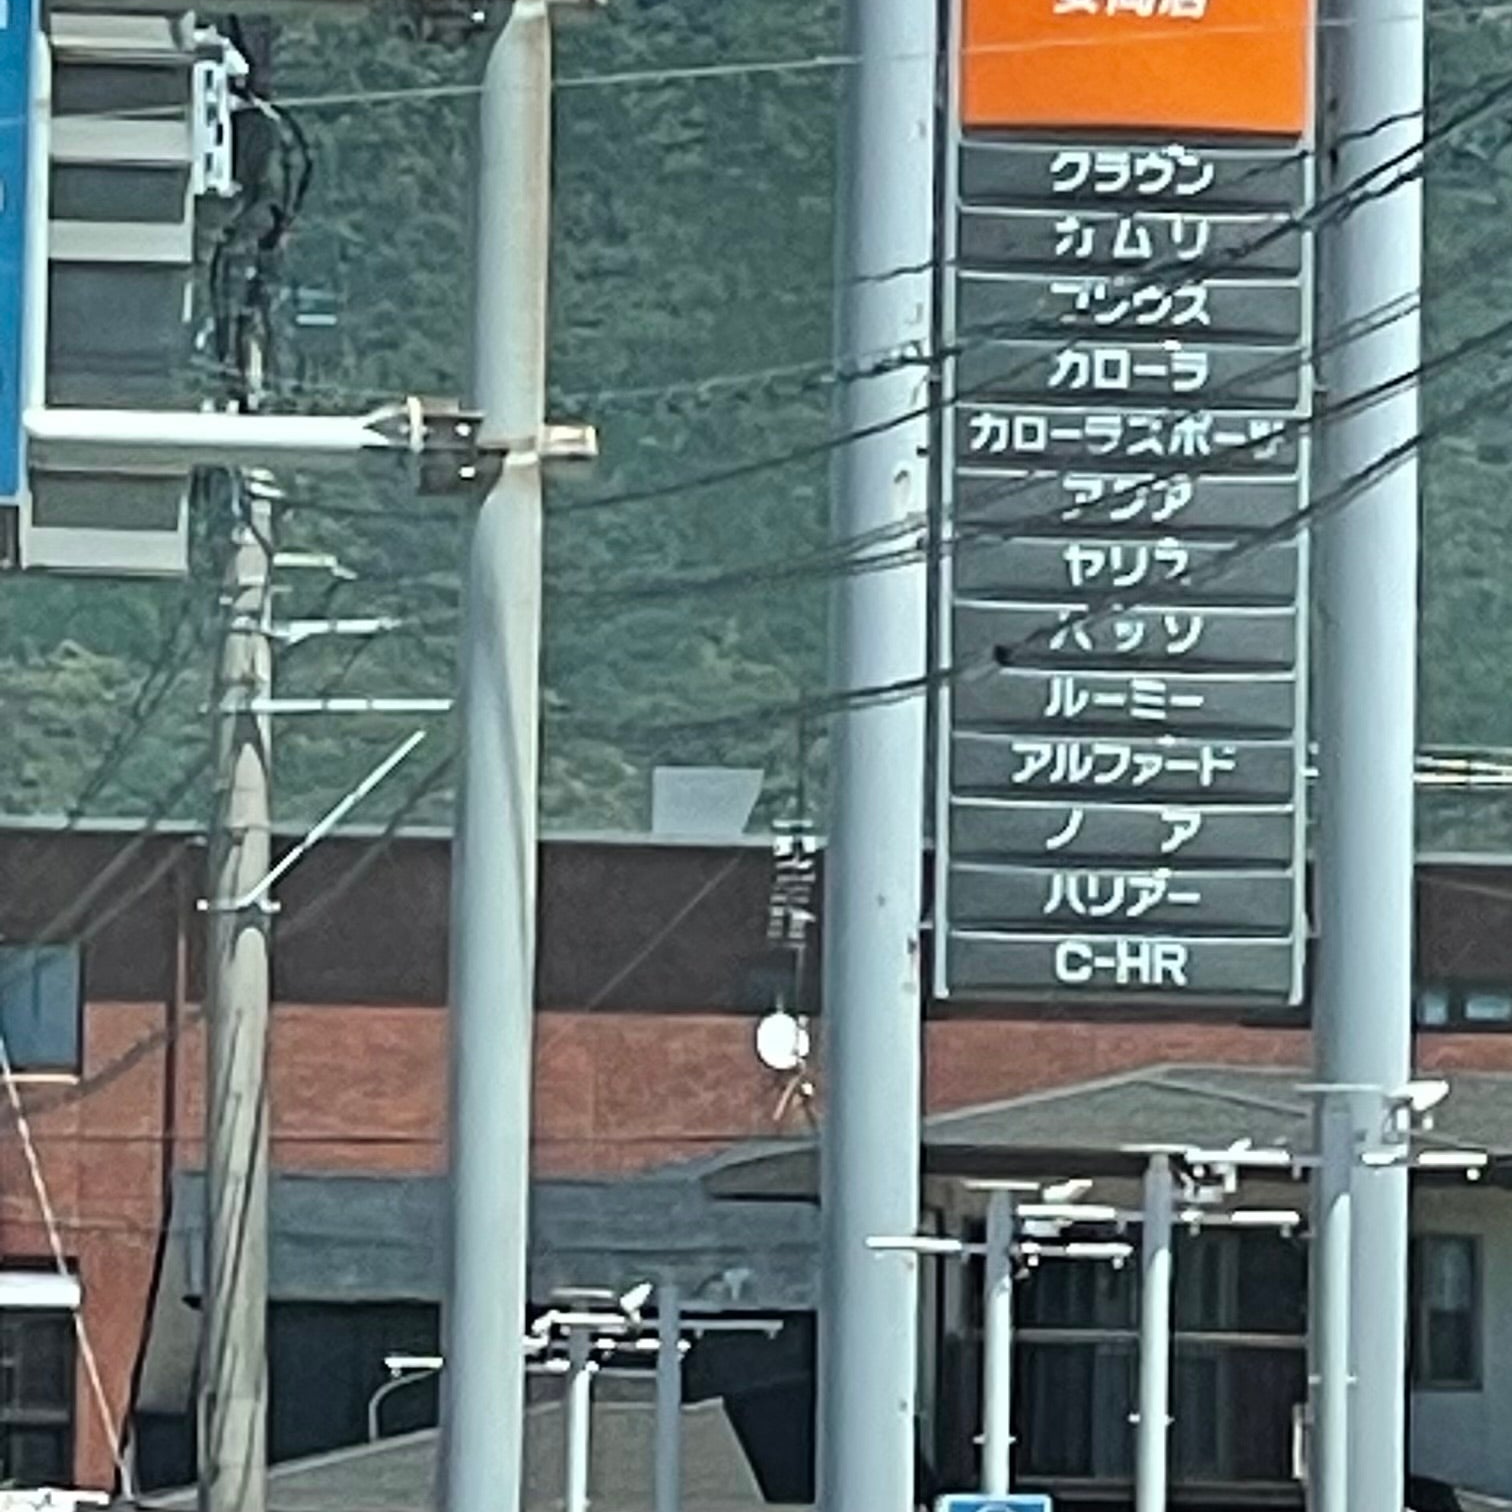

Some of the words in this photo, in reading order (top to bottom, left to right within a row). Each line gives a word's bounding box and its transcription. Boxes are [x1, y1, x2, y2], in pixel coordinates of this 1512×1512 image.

[1049, 150, 1213, 195] クラウン
[1047, 348, 1209, 392] カローラ
[1044, 676, 1204, 720] ルーミー
[1012, 742, 1236, 786] アルファード
[1044, 873, 1201, 917] ハリアー
[1055, 940, 1188, 986] C-HR
